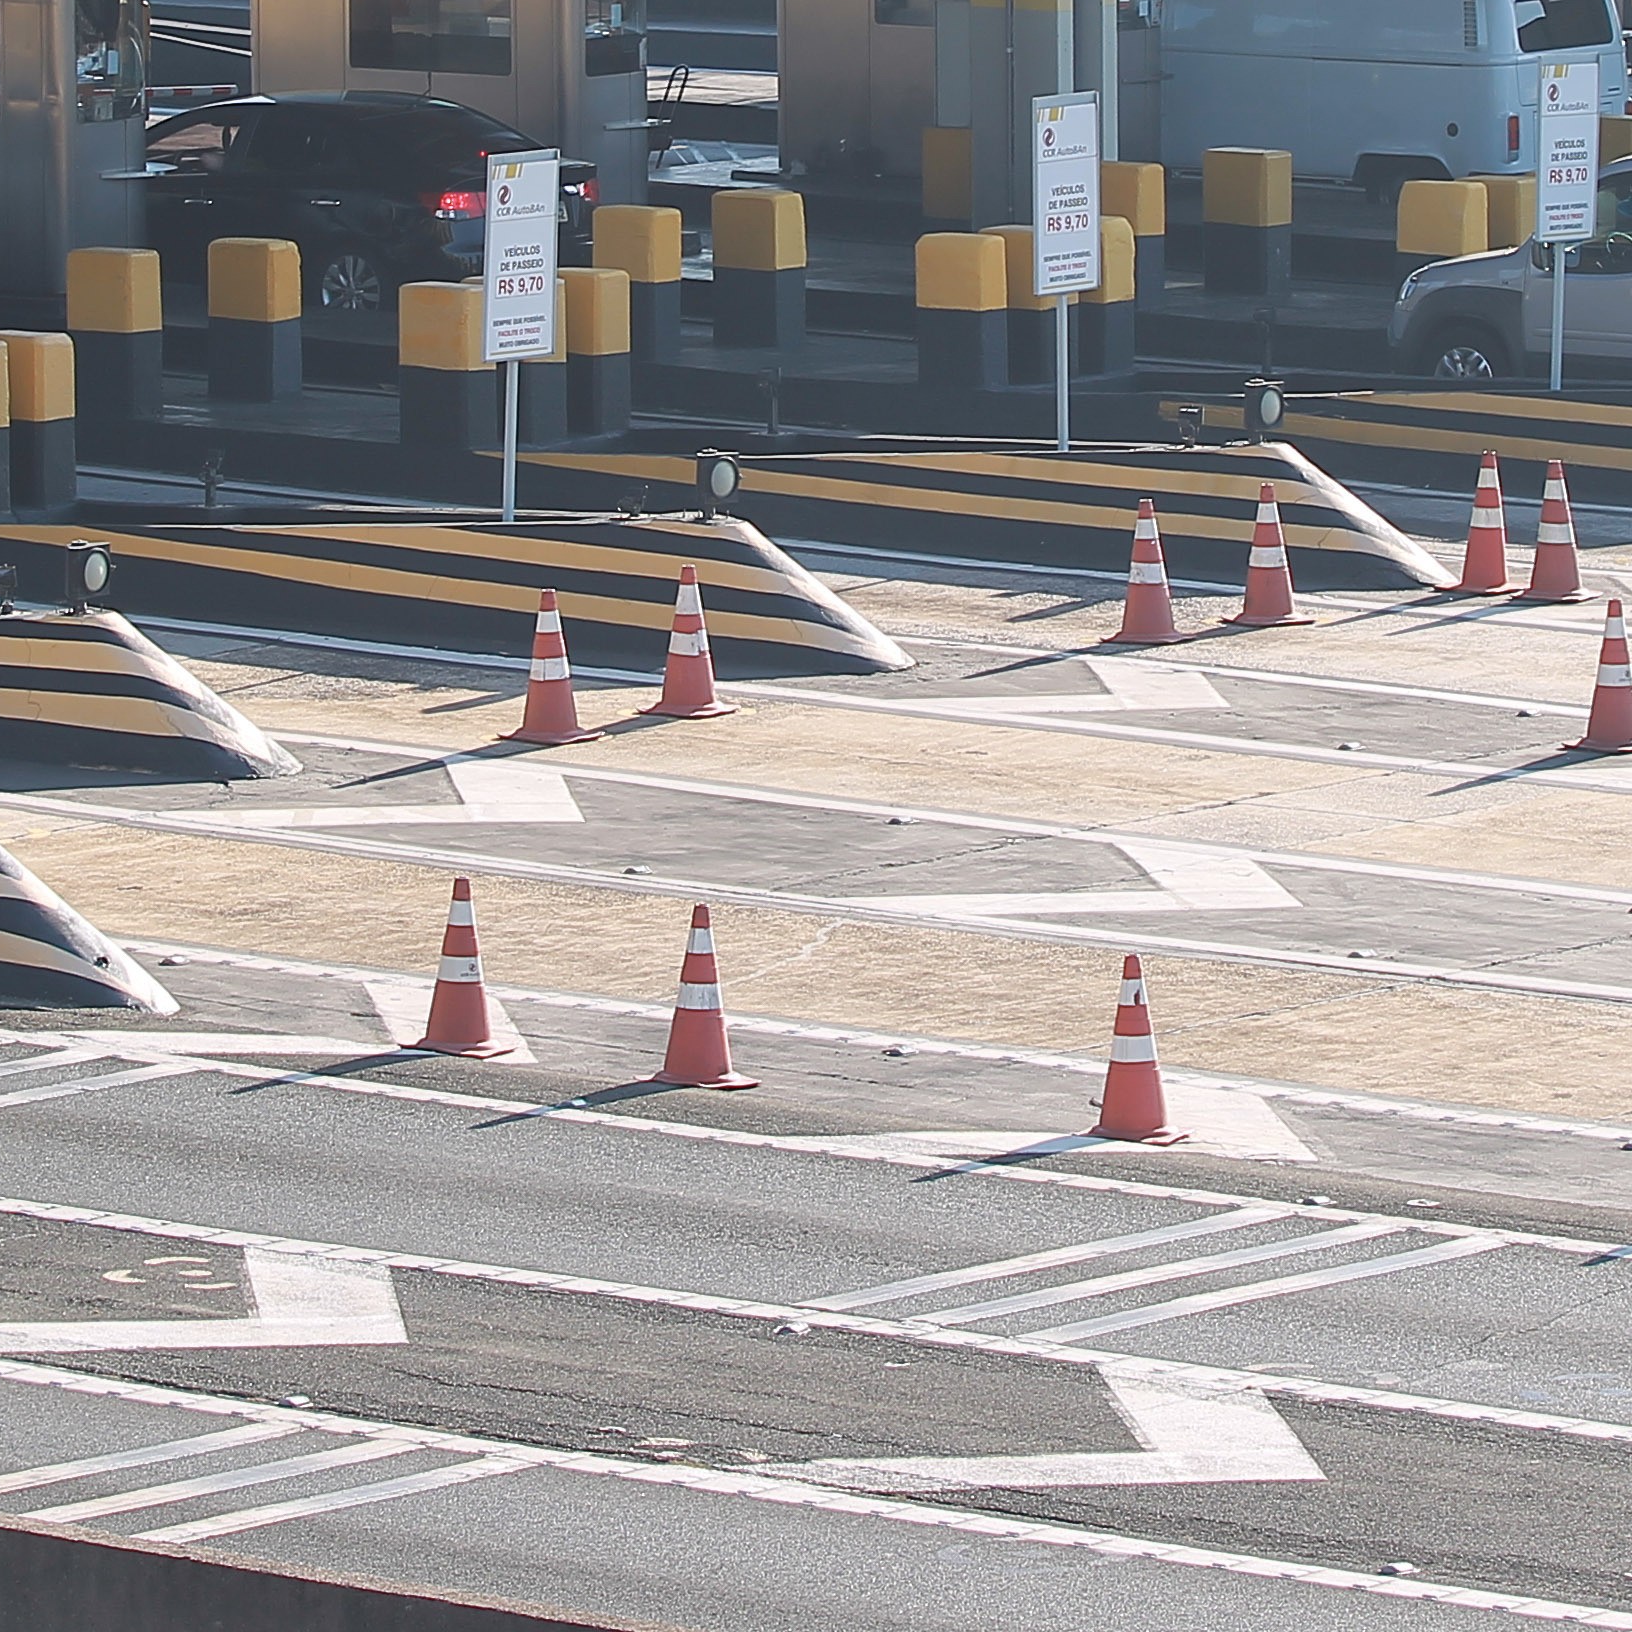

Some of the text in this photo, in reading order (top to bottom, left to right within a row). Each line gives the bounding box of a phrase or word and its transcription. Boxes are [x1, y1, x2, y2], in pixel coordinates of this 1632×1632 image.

[1554, 138, 1585, 149] VEÍCULOS
[1551, 151, 1588, 162] DE PASSEIO
[1549, 168, 1588, 184] R$ 9,70
[1051, 183, 1085, 197] VEÍCULOS
[1048, 197, 1088, 210] DE PASSEIO
[496, 206, 511, 217] CCR
[1047, 214, 1089, 232] R$ 9,70
[504, 243, 541, 258] VEÍCULOS
[500, 257, 544, 272] DE PASSEIO
[498, 275, 544, 295] R$ 9,70
